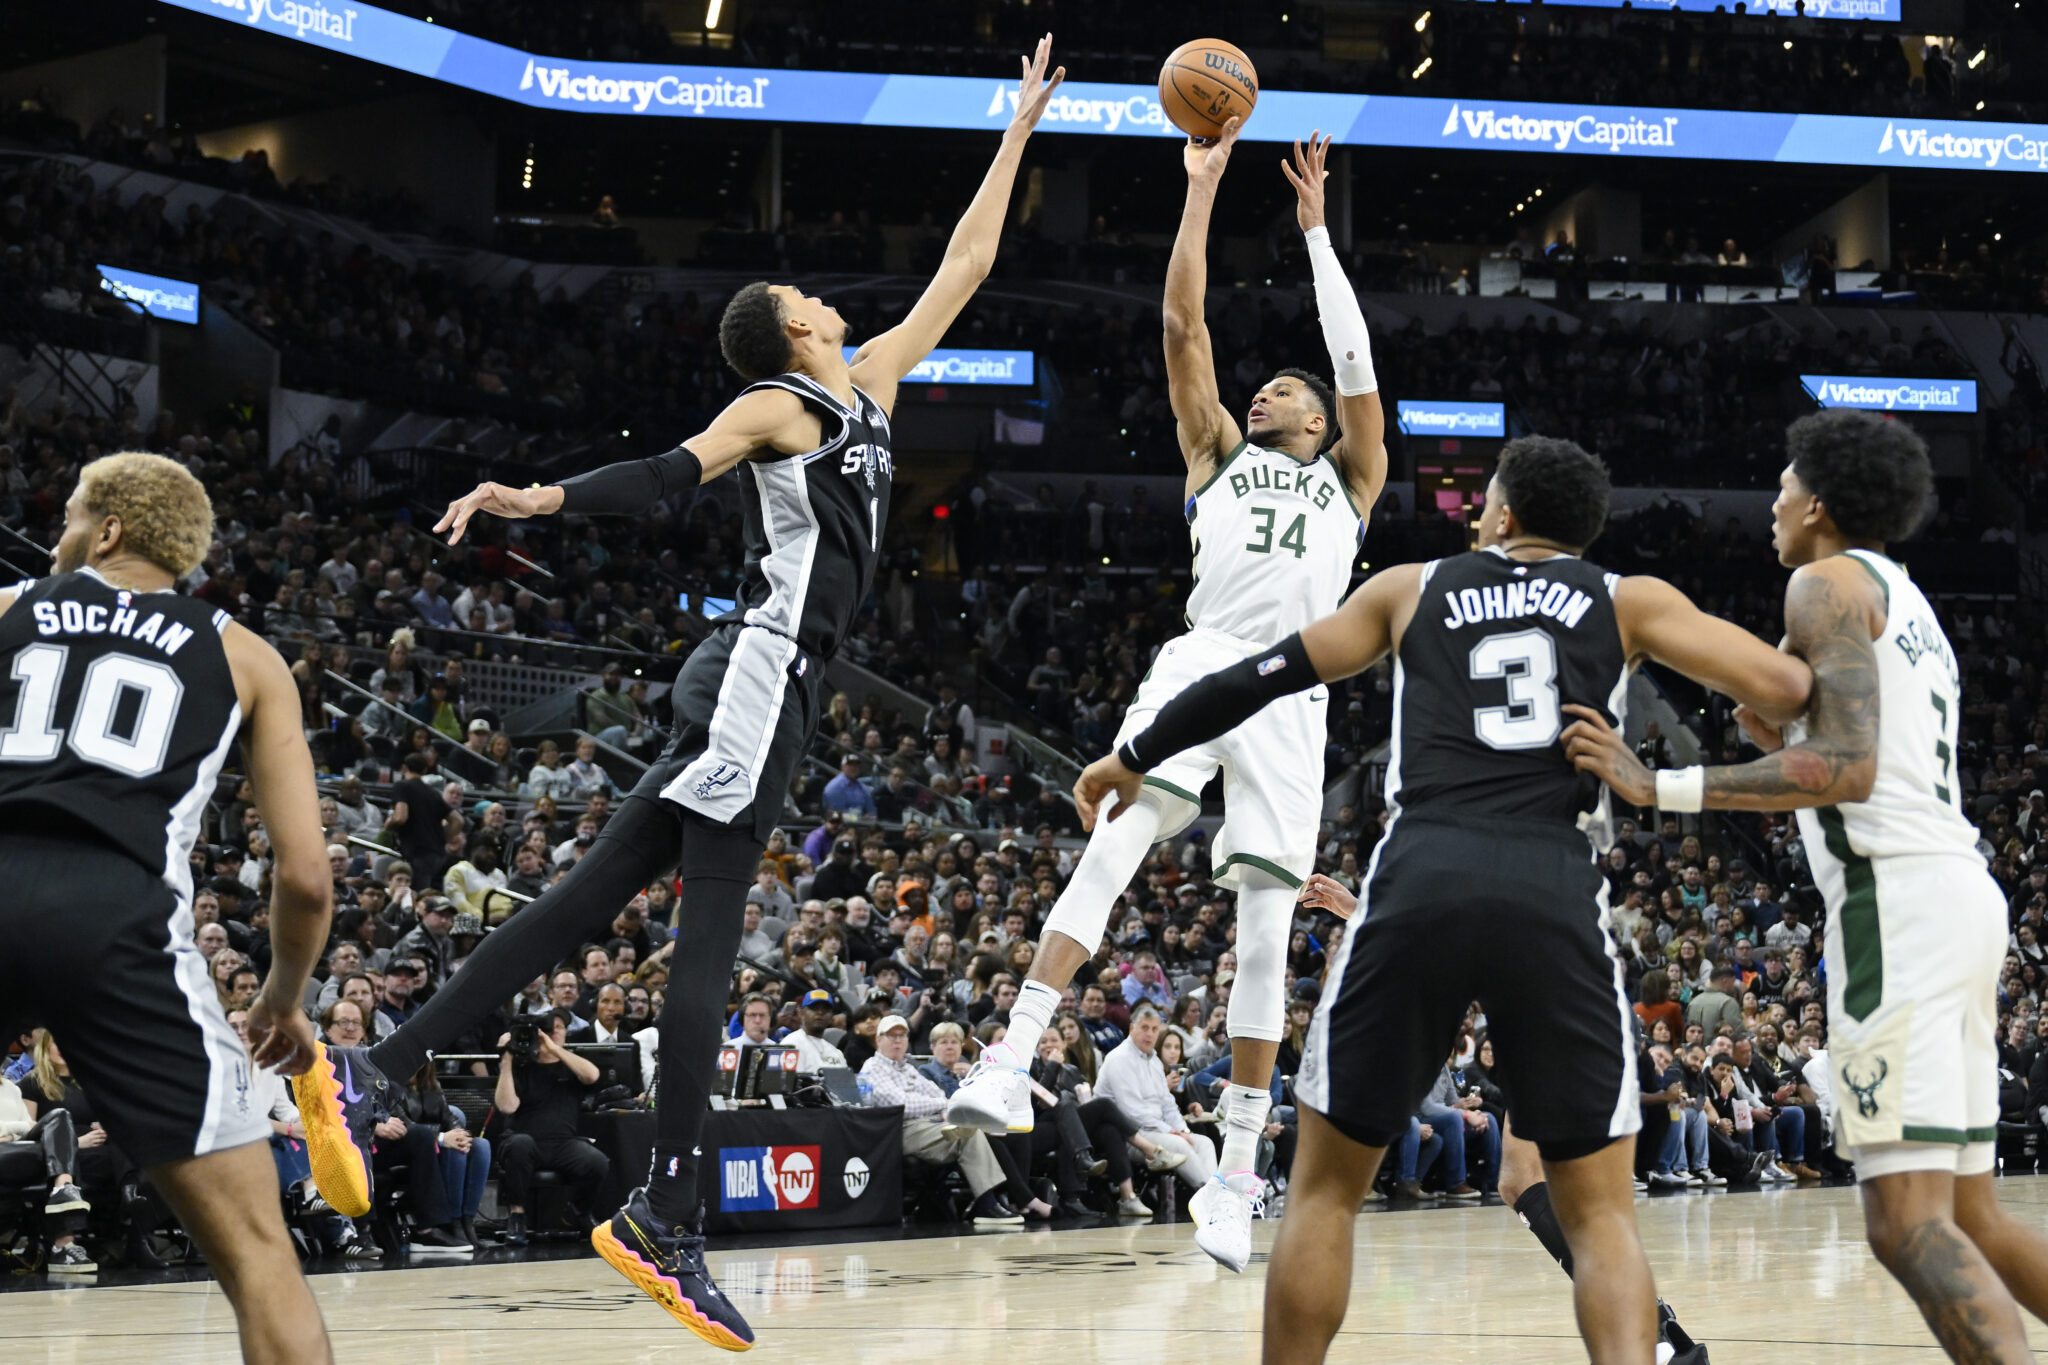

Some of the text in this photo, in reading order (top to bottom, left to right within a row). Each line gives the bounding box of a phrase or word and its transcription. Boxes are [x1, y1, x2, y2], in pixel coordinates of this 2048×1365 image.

[534, 66, 770, 114] VictoryCapital
[1204, 52, 1257, 98] Wilson
[1460, 109, 1679, 152] VictoryCapital
[1829, 383, 1961, 409] VictoryCapital
[1229, 464, 1336, 511] BUCKS
[1245, 506, 1307, 559] 34
[1444, 577, 1594, 630] JOHNSON
[32, 600, 195, 656] SOCHAN
[0, 641, 186, 779] 10
[1469, 626, 1563, 751] 3
[725, 1159, 815, 1199] NBA TNT
[843, 1170, 870, 1190] TNT
